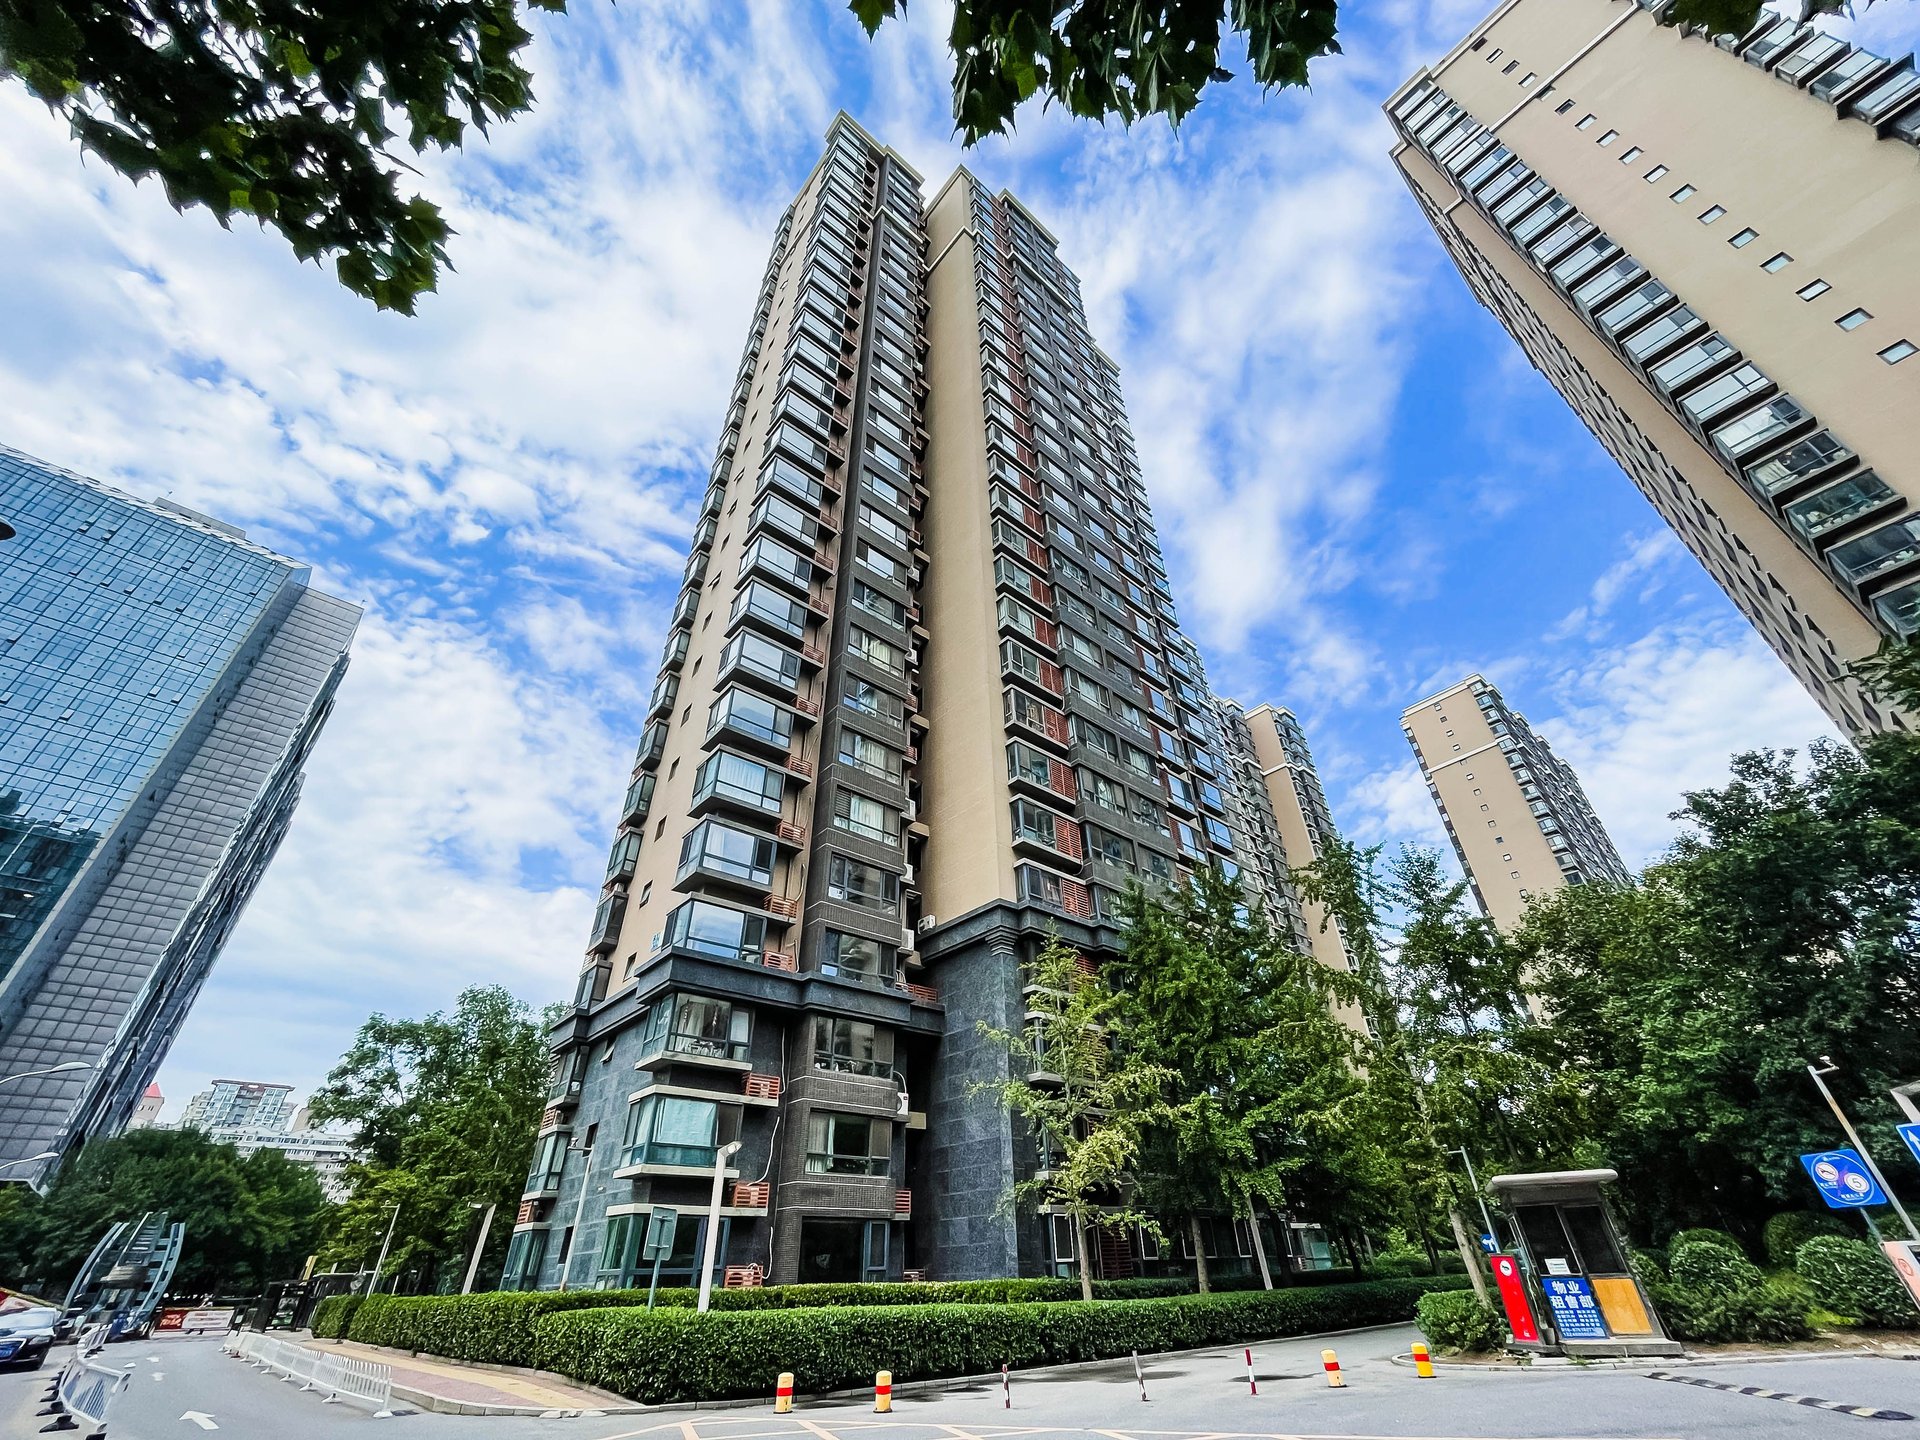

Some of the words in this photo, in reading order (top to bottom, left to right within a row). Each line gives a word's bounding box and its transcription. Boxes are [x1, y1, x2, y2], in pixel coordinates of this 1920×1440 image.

[1852, 1178, 1862, 1189] 5
[1551, 1281, 1582, 1294] 物业
[1549, 1295, 1595, 1309] 租售部
